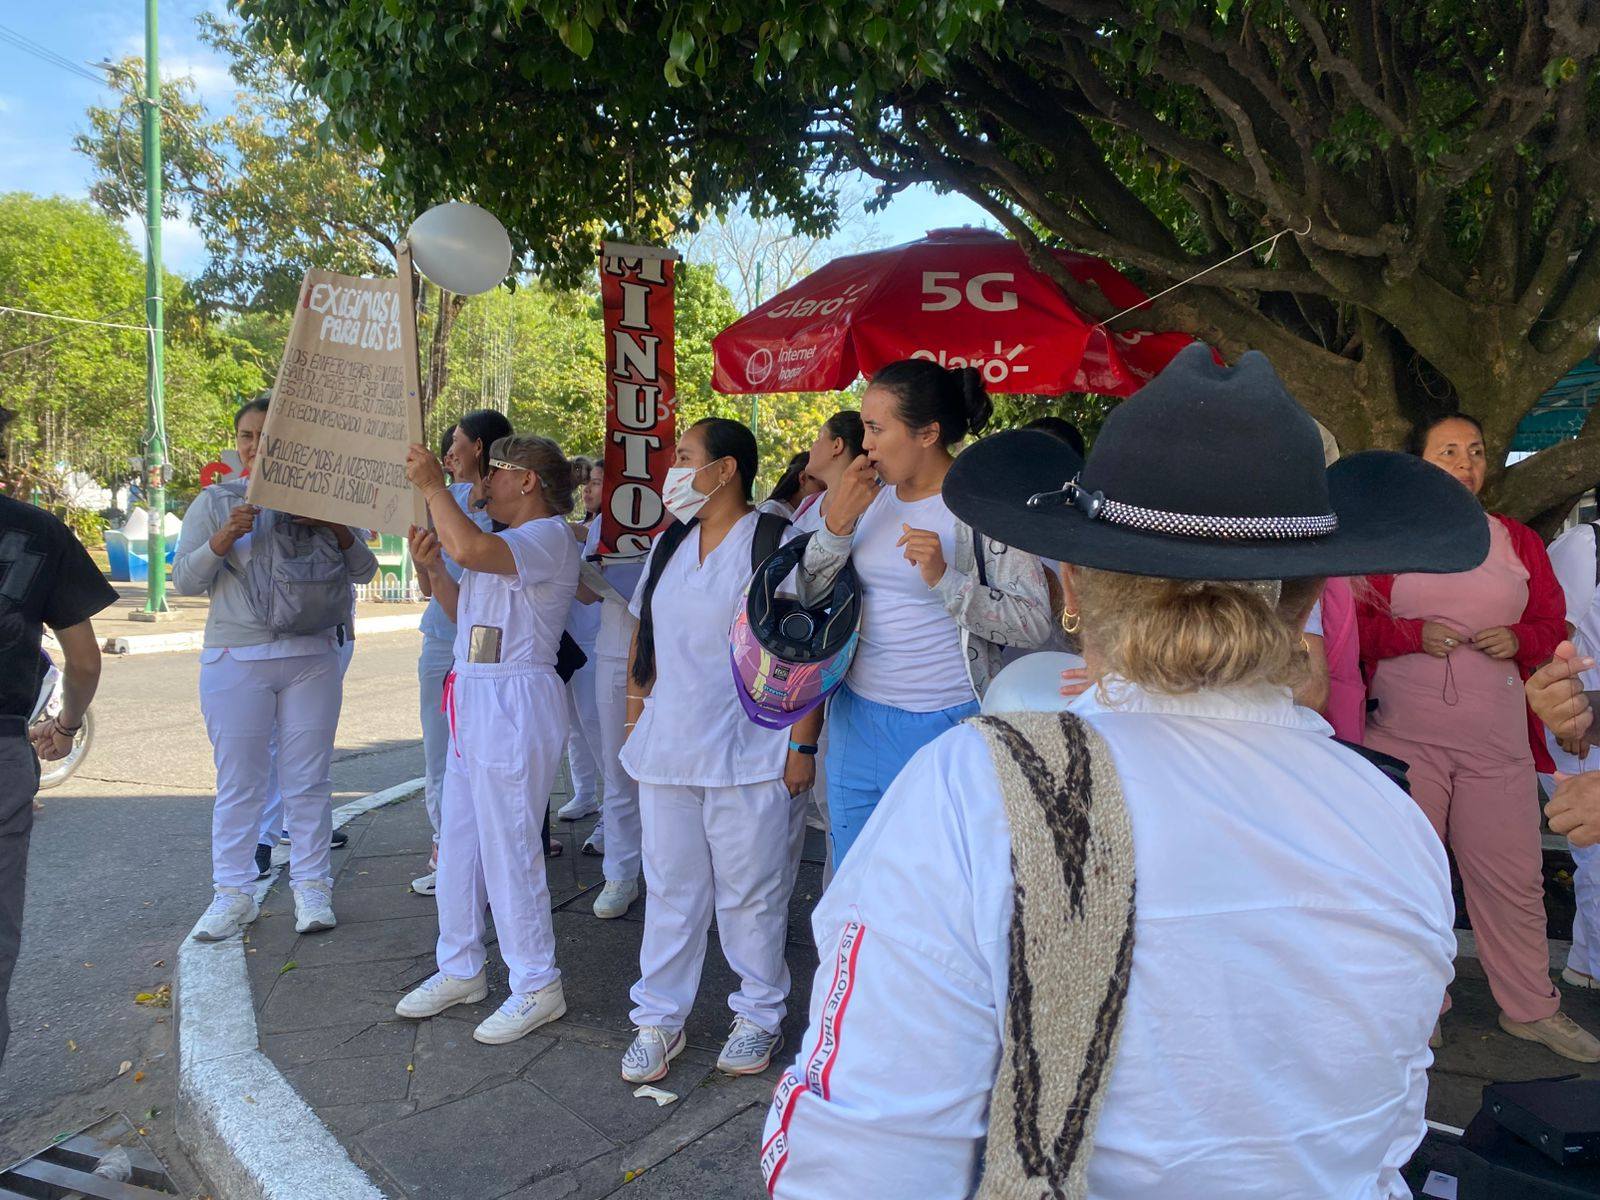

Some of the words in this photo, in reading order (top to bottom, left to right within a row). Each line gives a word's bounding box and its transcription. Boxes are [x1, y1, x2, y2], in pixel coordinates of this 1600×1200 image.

[766, 296, 843, 318] Claro
[921, 271, 1019, 312] 5G
[320, 315, 360, 345] PARA
[361, 320, 386, 350] LOS
[287, 347, 309, 366] LOS
[778, 344, 817, 362] Internet
[266, 435, 334, 471] VALOREMOS
[334, 453, 343, 474] A
[261, 458, 332, 495] VALOREMOS
[840, 953, 848, 963] A
[842, 934, 854, 949] IS
[828, 970, 848, 1010] LOVE
[822, 1015, 834, 1058] THAT
